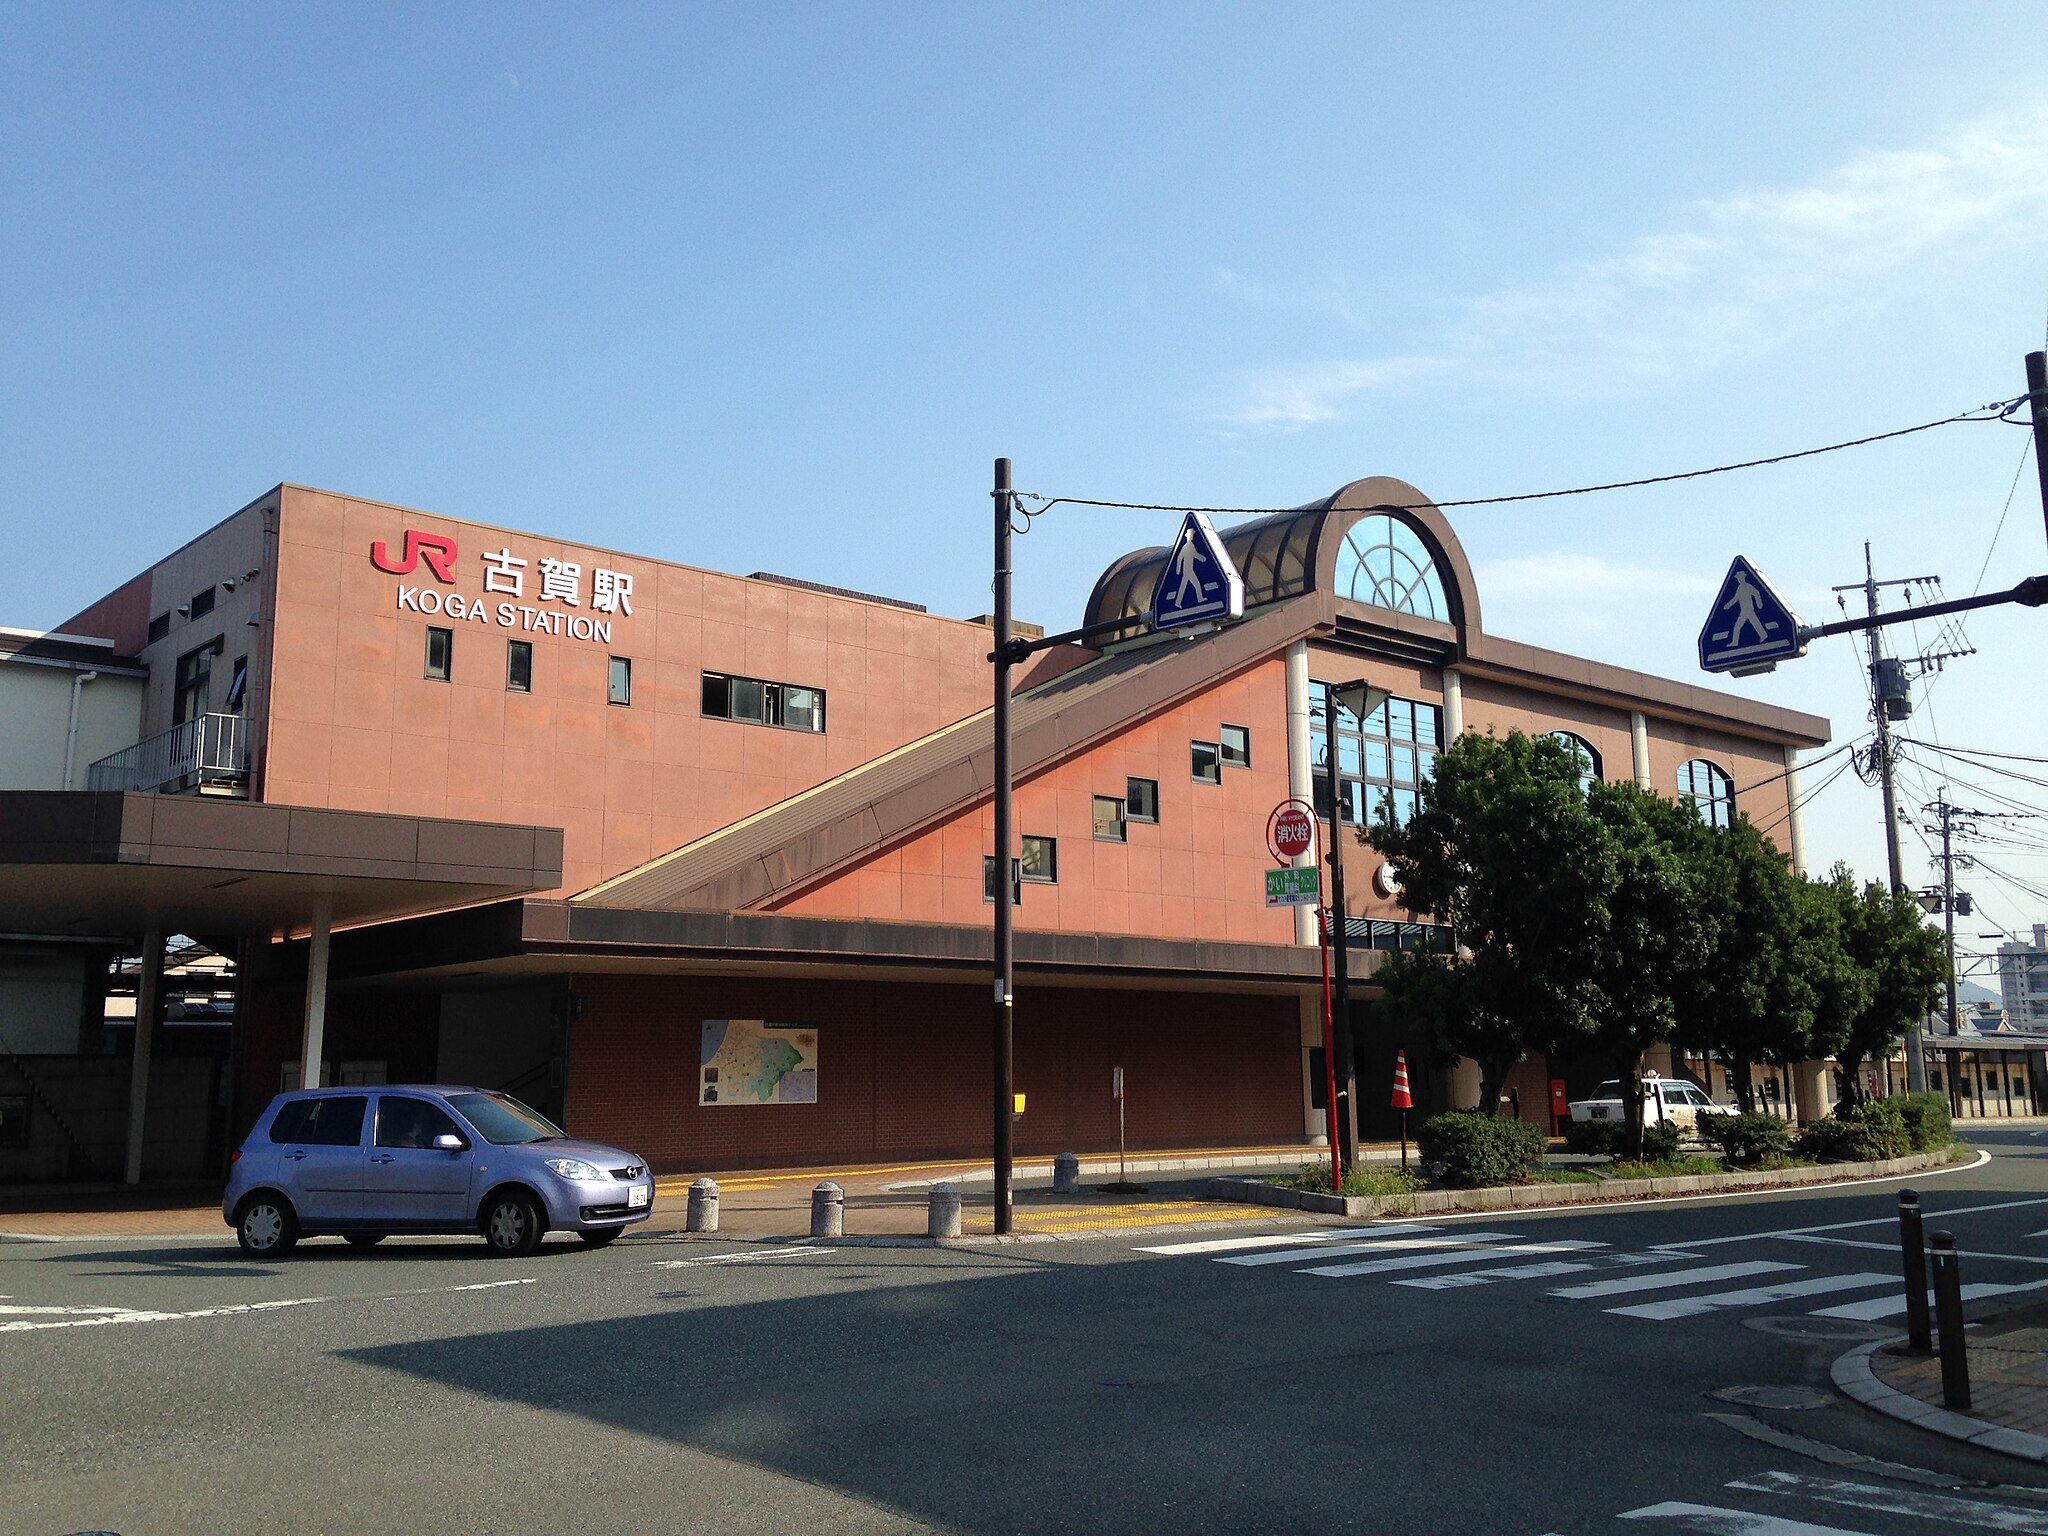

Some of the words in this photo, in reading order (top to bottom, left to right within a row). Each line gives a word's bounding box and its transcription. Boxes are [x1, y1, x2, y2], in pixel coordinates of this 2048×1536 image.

[371, 529, 458, 584] JR
[481, 548, 634, 616] 古賀駅
[398, 585, 488, 623] KOGA
[497, 602, 611, 643] STATION
[1277, 822, 1309, 843] 消火栓
